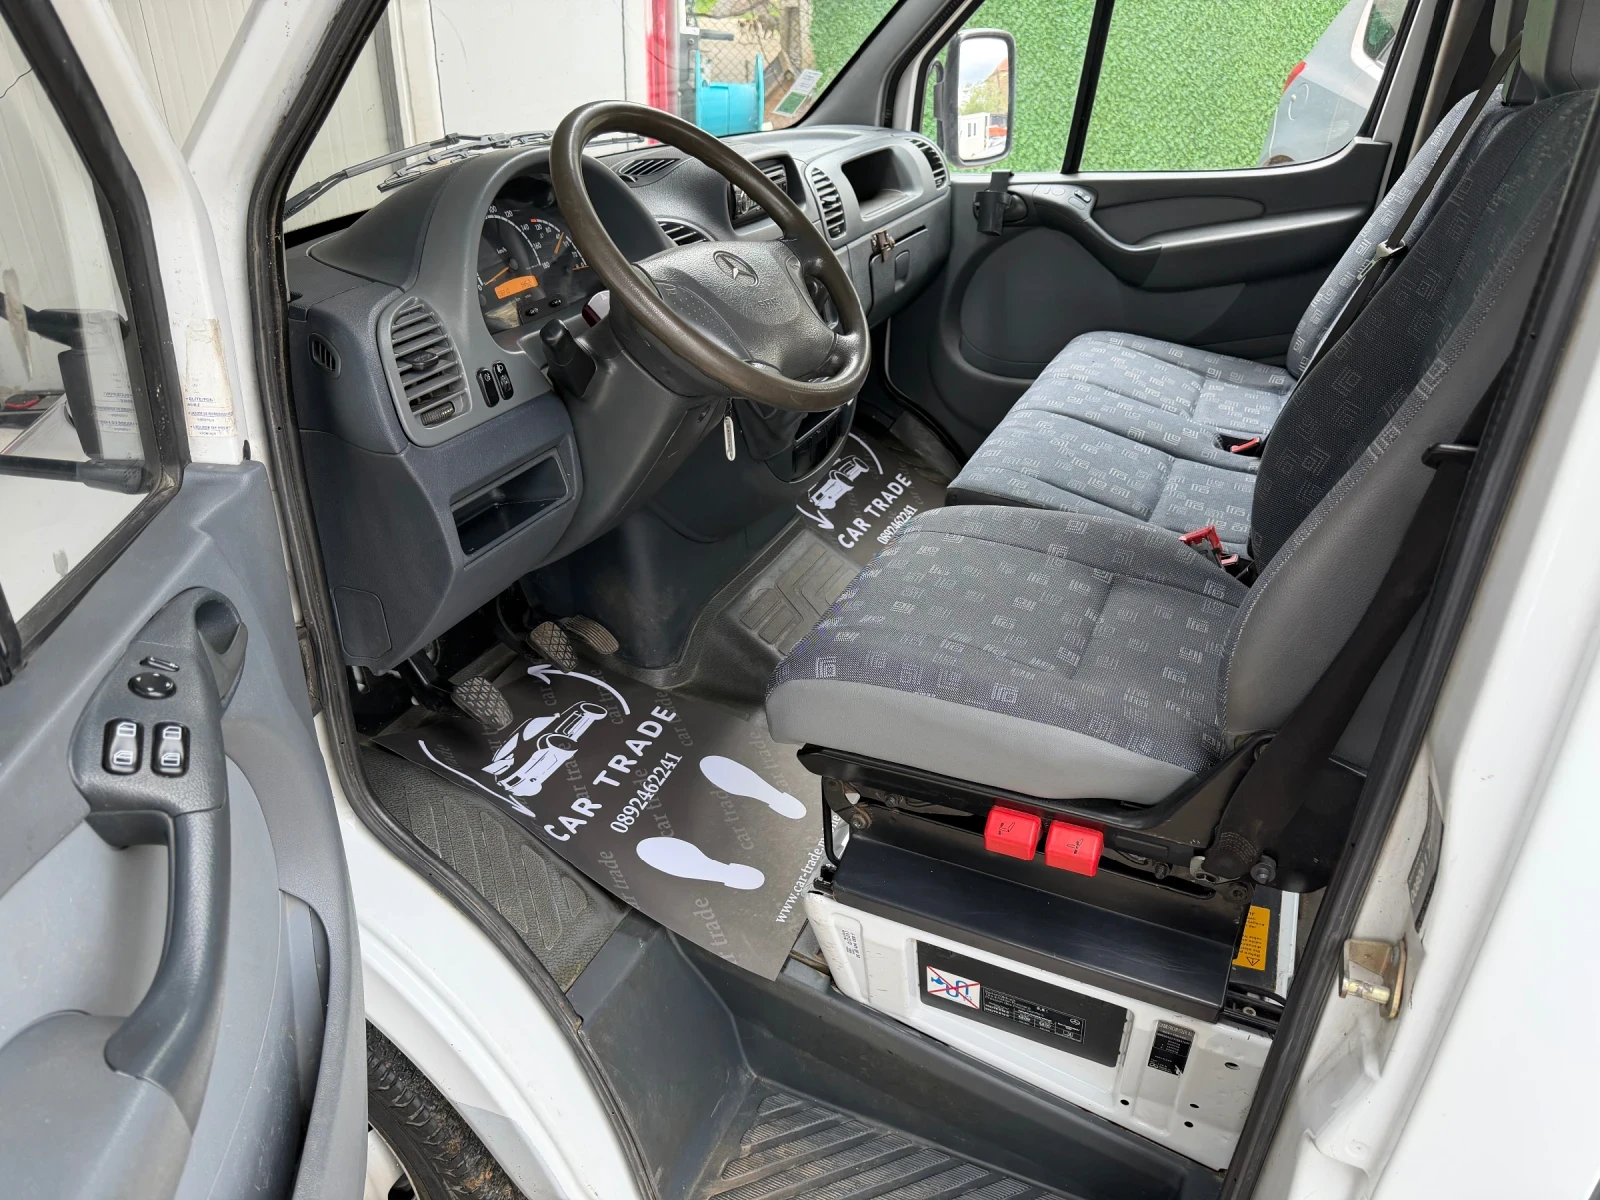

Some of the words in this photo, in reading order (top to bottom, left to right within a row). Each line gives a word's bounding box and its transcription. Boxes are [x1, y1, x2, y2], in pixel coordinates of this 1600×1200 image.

[838, 517, 872, 549] CAR
[863, 473, 912, 518] TRADE
[543, 797, 603, 842] CAR
[592, 705, 677, 787] TRADE
[610, 751, 683, 834] 0892462241
[598, 850, 630, 891] trade
[693, 897, 728, 948] trade
